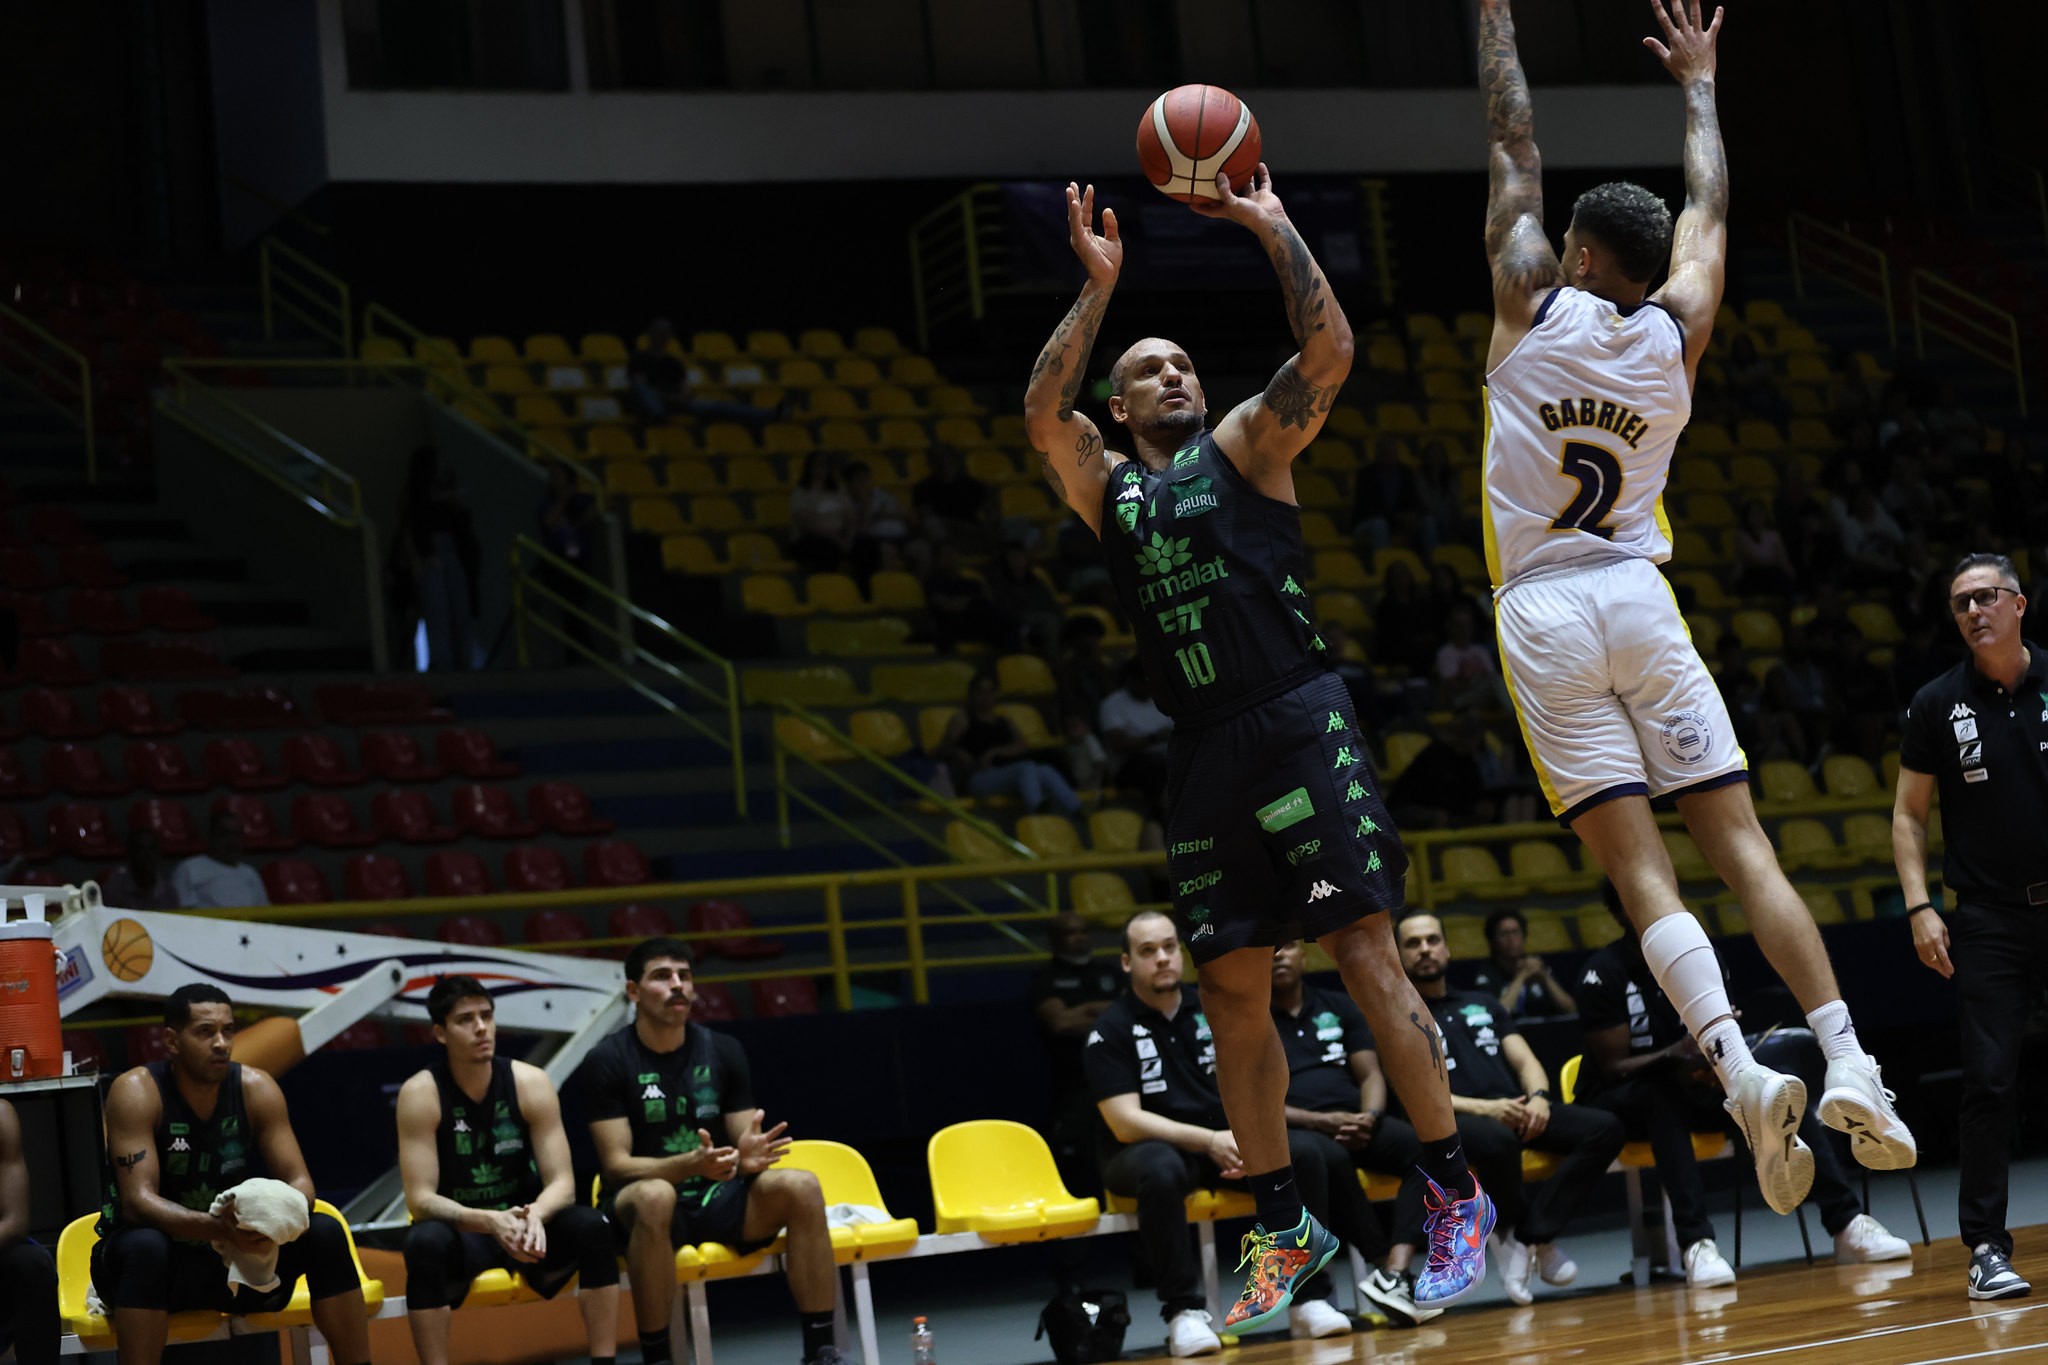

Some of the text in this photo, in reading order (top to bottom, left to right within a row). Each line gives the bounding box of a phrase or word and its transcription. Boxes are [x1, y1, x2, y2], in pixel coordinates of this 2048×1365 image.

[1539, 398, 1650, 449] GABRIEL
[1175, 494, 1217, 517] BAURU
[1547, 438, 1626, 541] 2
[1175, 642, 1216, 688] 10
[1263, 802, 1291, 823] Unimed
